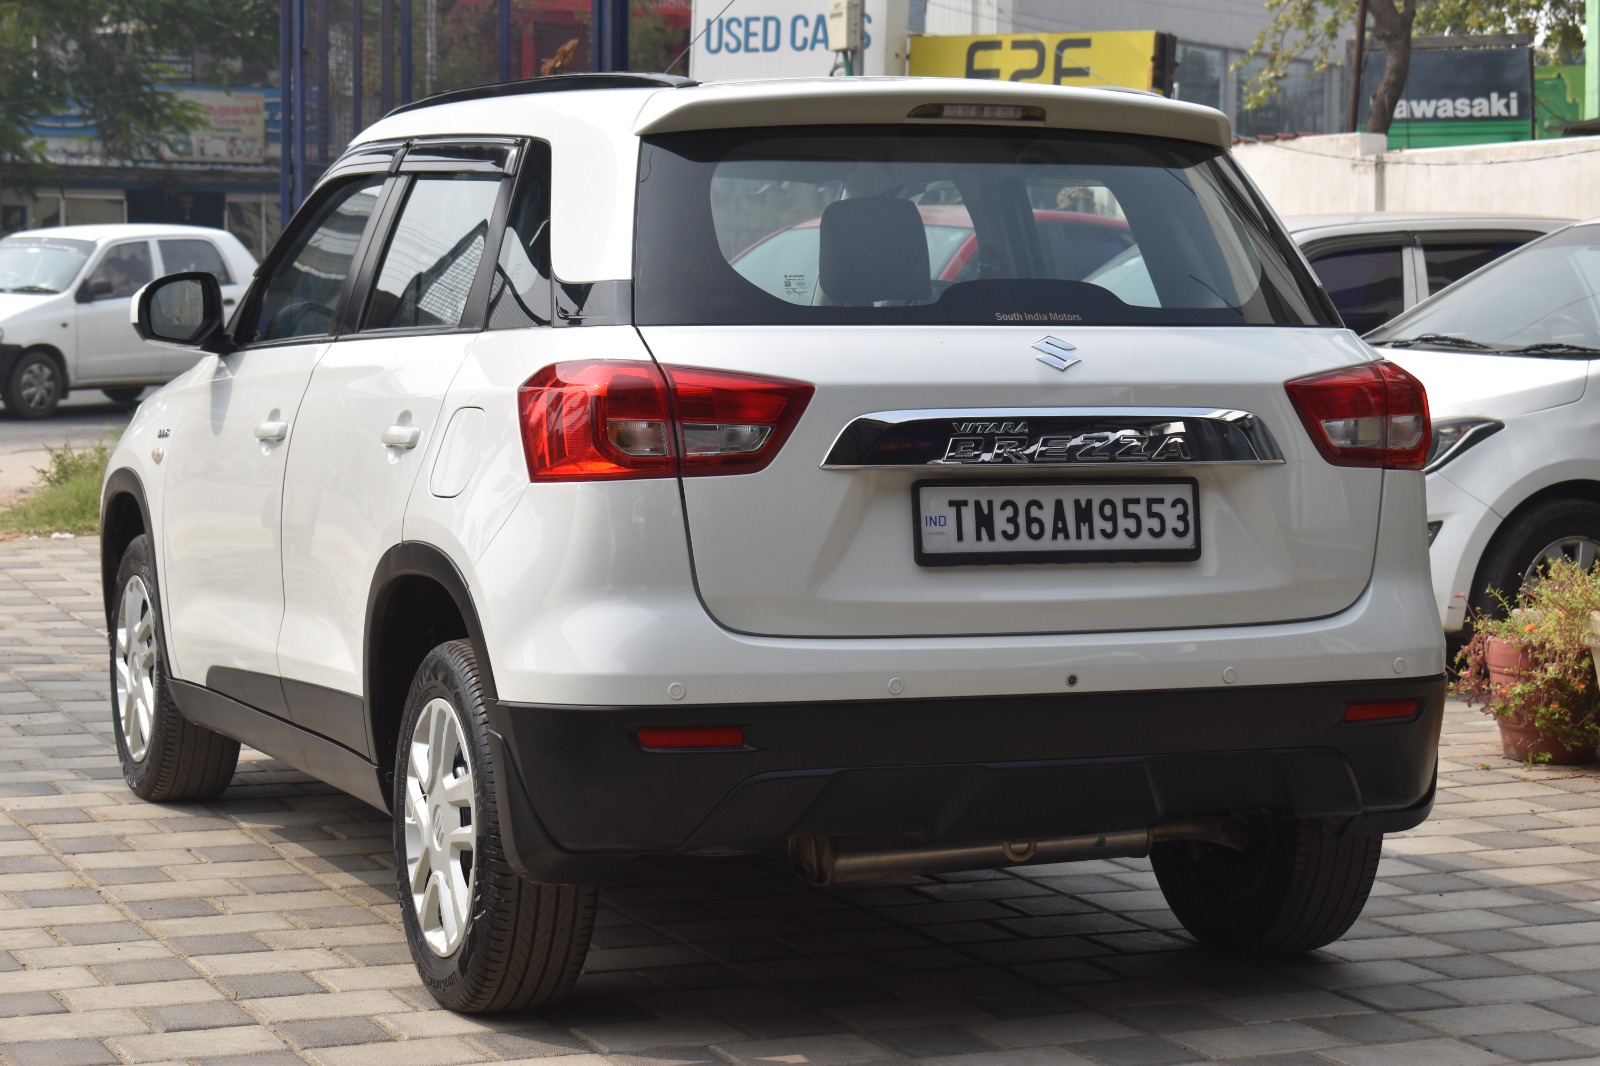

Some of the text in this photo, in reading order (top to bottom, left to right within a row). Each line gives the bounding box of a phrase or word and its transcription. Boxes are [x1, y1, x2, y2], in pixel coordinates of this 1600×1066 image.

[704, 12, 872, 54] USED CAS
[1392, 91, 1518, 119] awasaki
[995, 312, 1082, 321] South India Motors
[952, 421, 1029, 434] VITARA
[942, 434, 1192, 464] BREZZA
[925, 515, 947, 527] IND
[948, 497, 1190, 542] TN36AM9553
